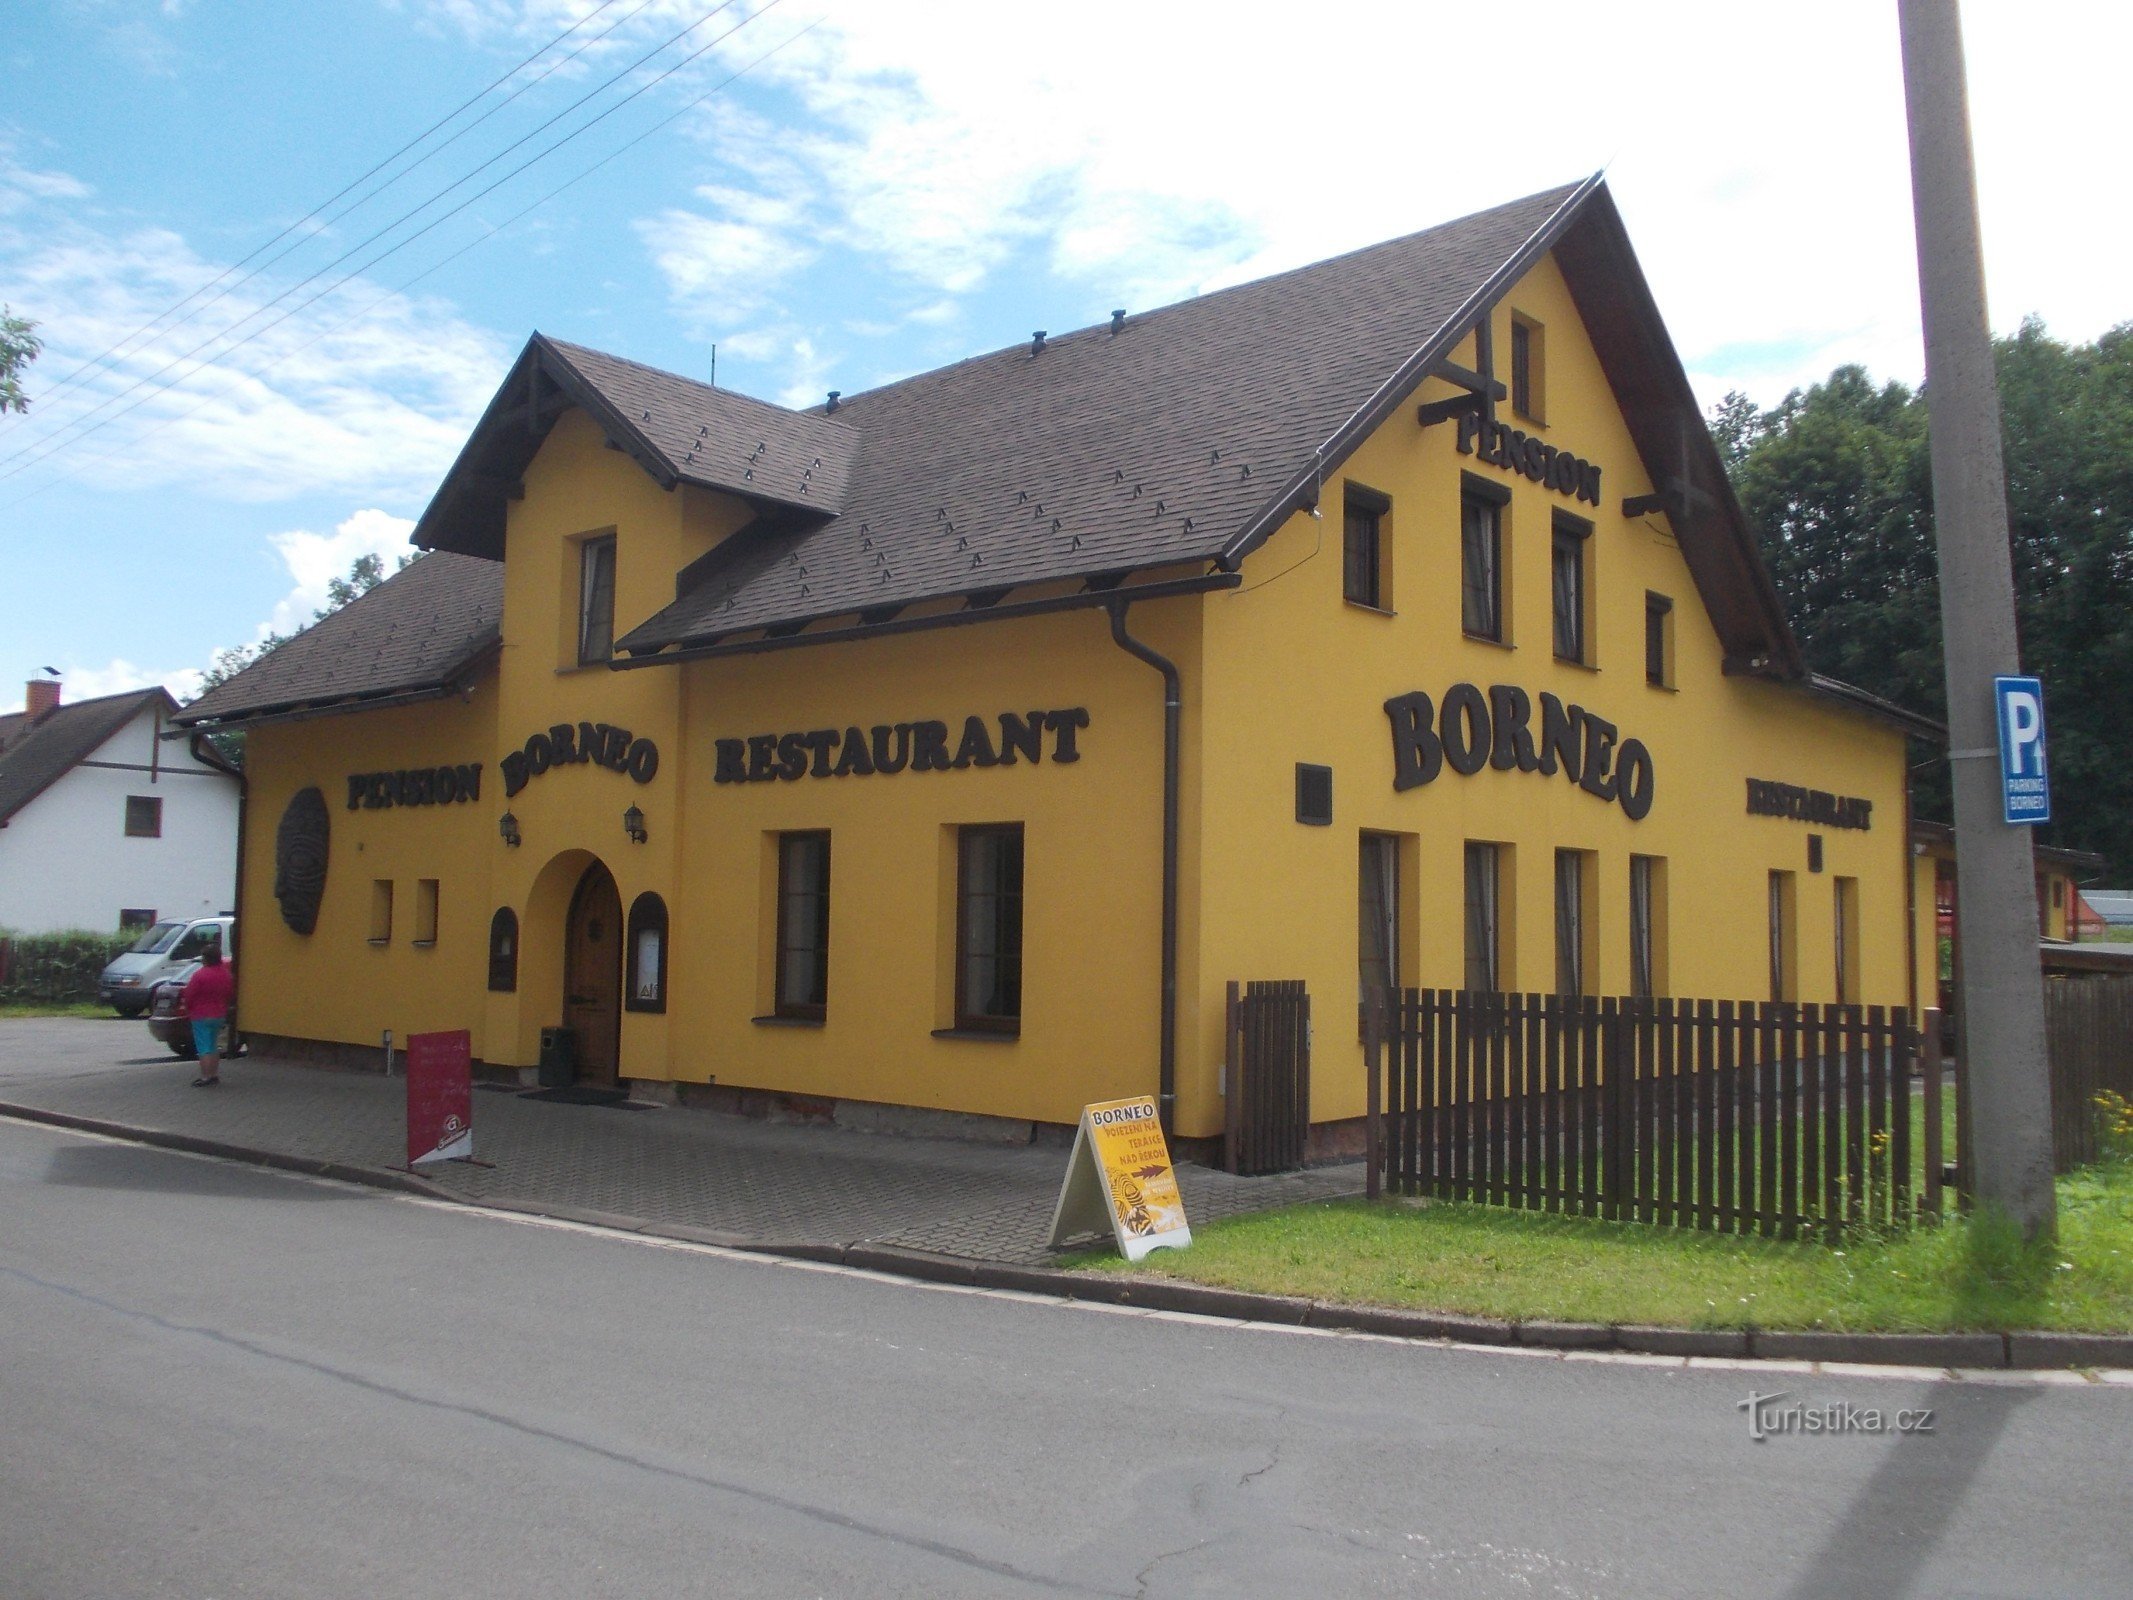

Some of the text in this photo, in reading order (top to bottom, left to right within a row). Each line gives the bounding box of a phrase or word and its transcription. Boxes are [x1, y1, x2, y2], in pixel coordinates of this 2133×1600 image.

[1456, 412, 1601, 507] PENSION
[714, 707, 1090, 783] RESTAURANT
[1384, 683, 1654, 821] BORNEO
[2006, 691, 2039, 774] P
[500, 722, 658, 797] BORNEO
[2008, 778, 2044, 792] PARKING
[347, 763, 483, 810] PENSION
[1745, 778, 1872, 830] RESTAURANT
[2010, 795, 2045, 810] BORNEO
[1093, 1104, 1154, 1125] BORNEO
[1119, 1154, 1138, 1166] NAD
